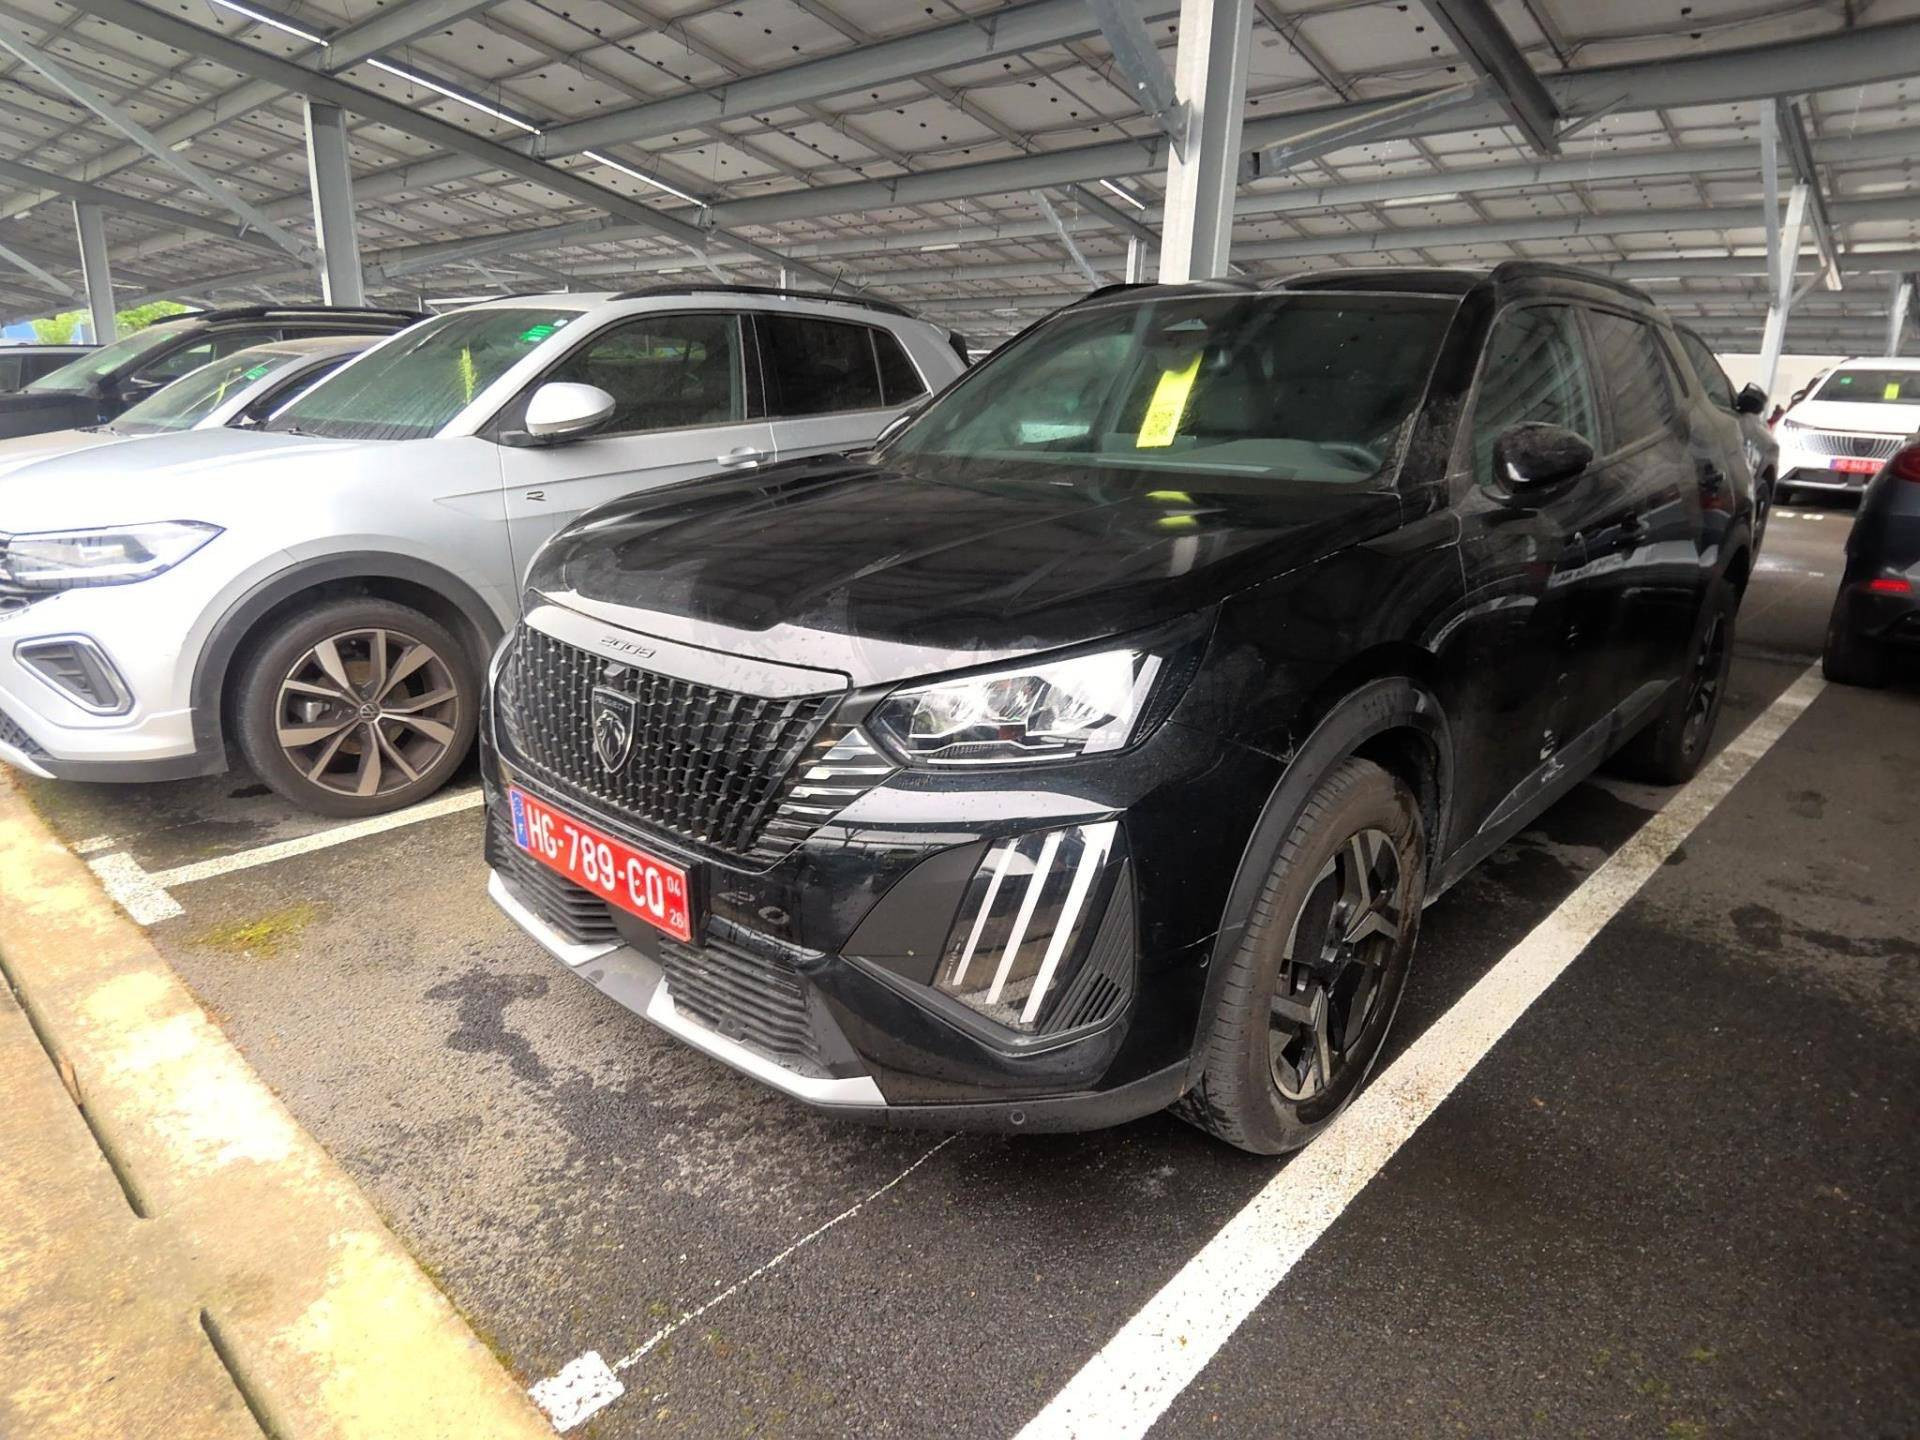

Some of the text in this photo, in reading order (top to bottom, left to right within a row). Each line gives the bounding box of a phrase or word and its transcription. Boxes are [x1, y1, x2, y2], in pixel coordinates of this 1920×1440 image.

[600, 637, 657, 659] 2008
[594, 695, 631, 712] PEUGEOT
[526, 803, 665, 919] HG-789-CQ
[667, 875, 682, 897] 04
